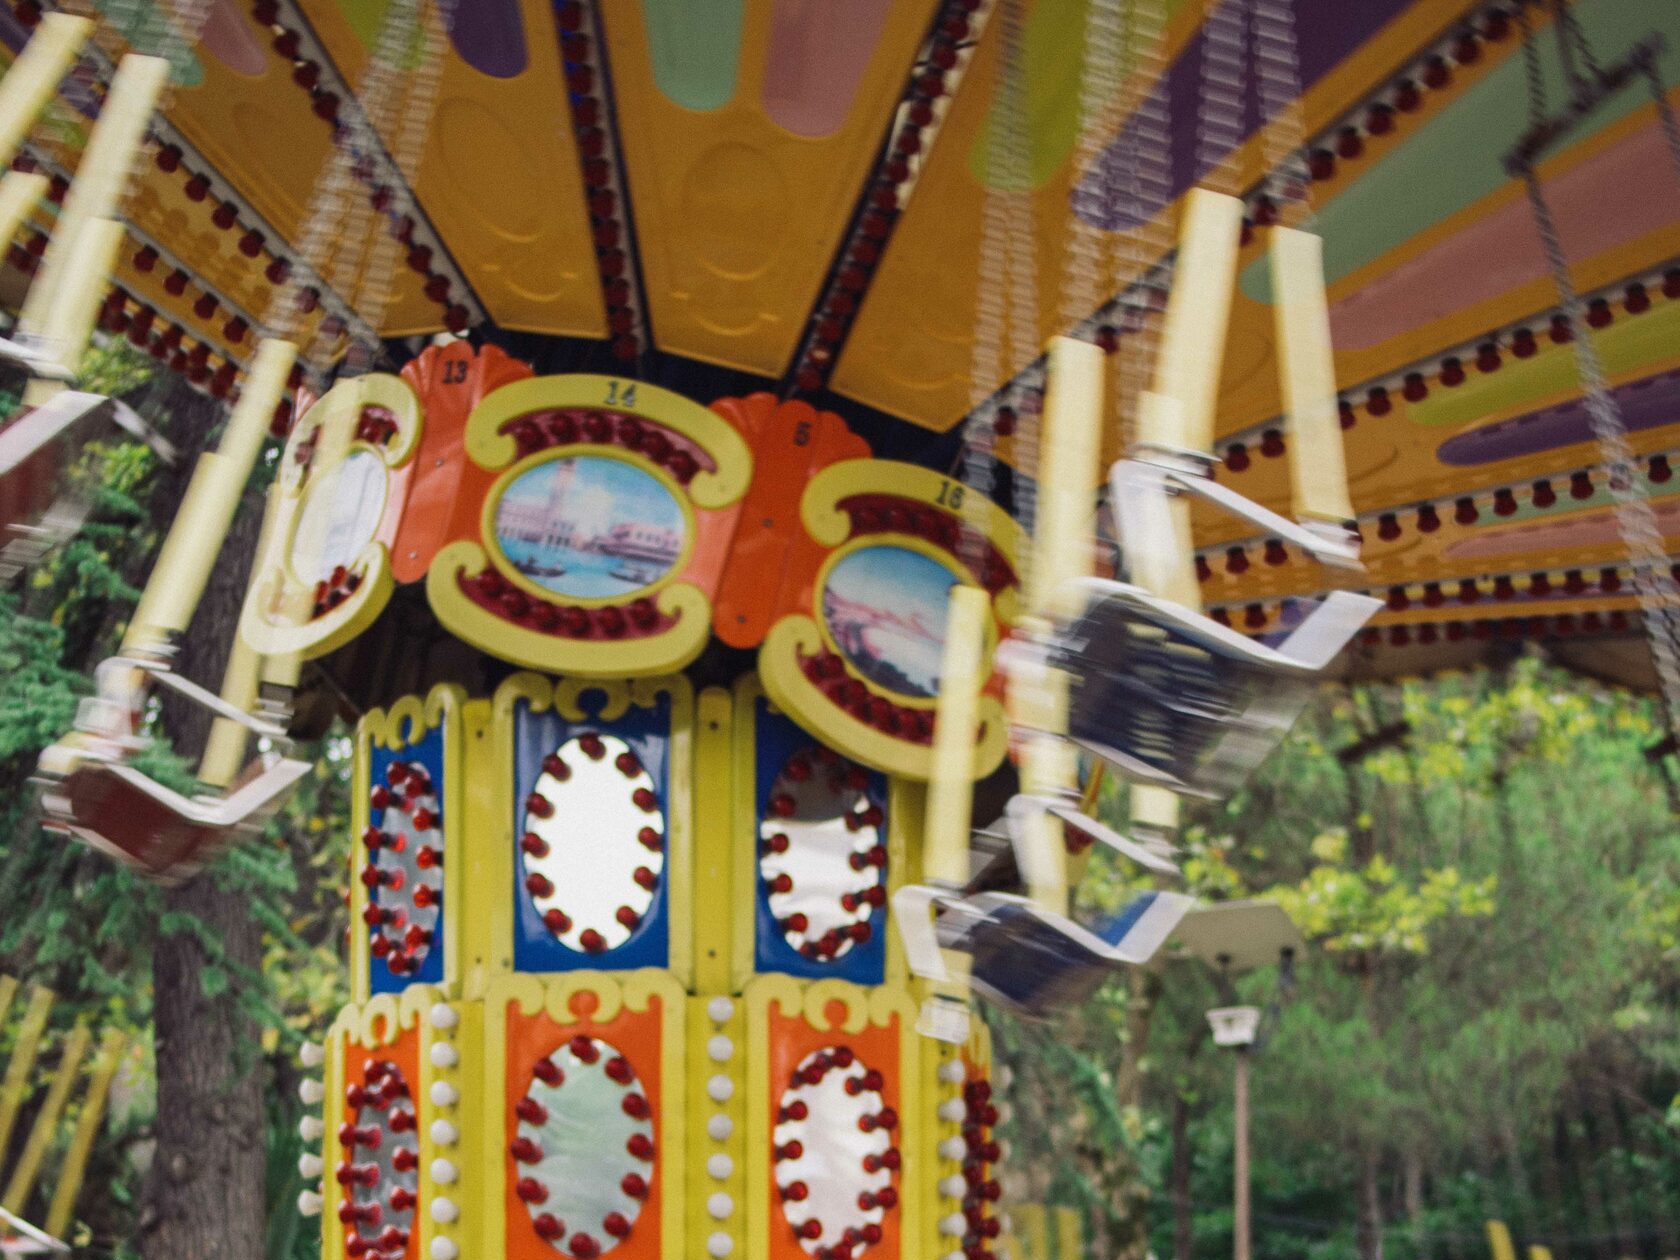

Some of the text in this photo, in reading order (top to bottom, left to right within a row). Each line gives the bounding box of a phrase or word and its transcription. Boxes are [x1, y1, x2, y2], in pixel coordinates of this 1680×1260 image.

[443, 359, 468, 384] 13
[603, 381, 636, 407] 14
[935, 480, 965, 510] 16
